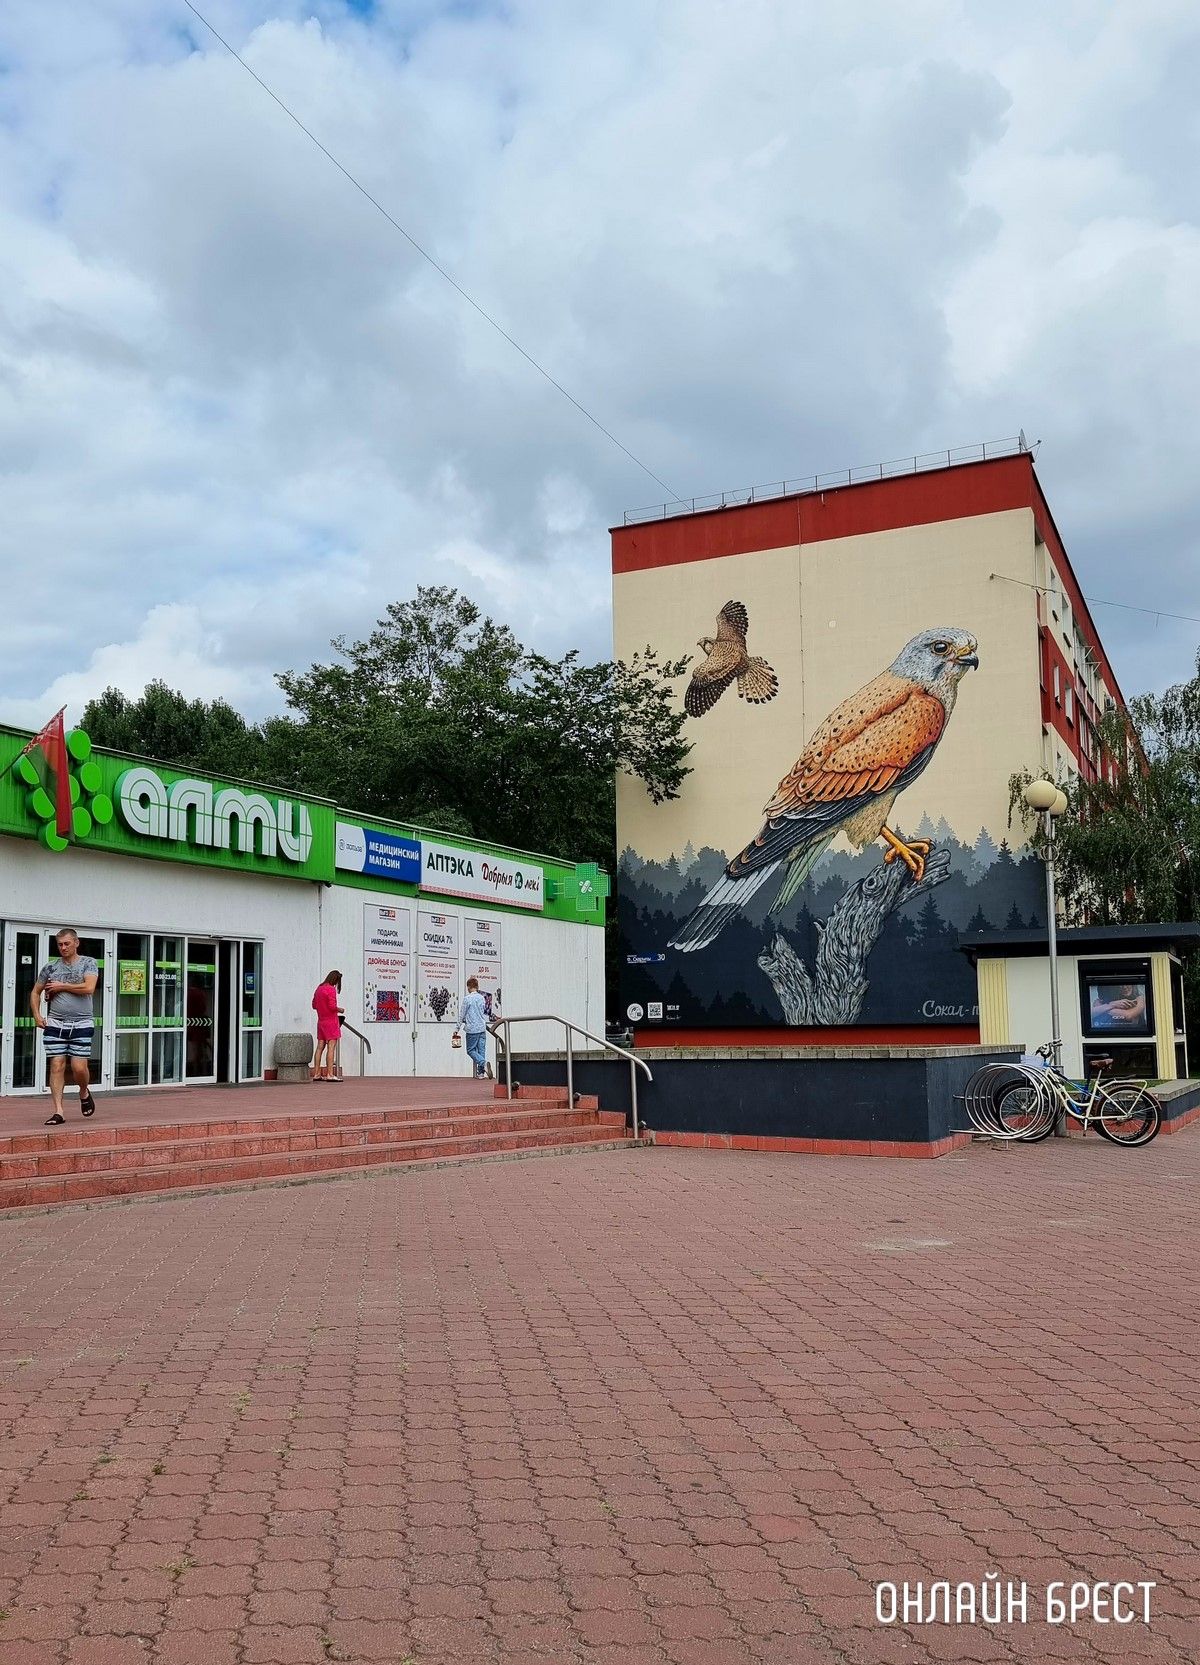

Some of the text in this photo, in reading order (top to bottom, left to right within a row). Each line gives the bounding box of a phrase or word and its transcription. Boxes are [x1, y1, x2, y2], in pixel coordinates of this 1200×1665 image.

[369, 841, 419, 861] МЕДИЦИНСКИЙ
[369, 854, 400, 870] МАГАЗИН
[427, 852, 474, 878] АПТЭКА
[482, 863, 540, 891] Добрыя лекі
[377, 928, 399, 938] ПОДАРОК
[424, 932, 446, 944] СКИДКА
[657, 953, 666, 961] 30
